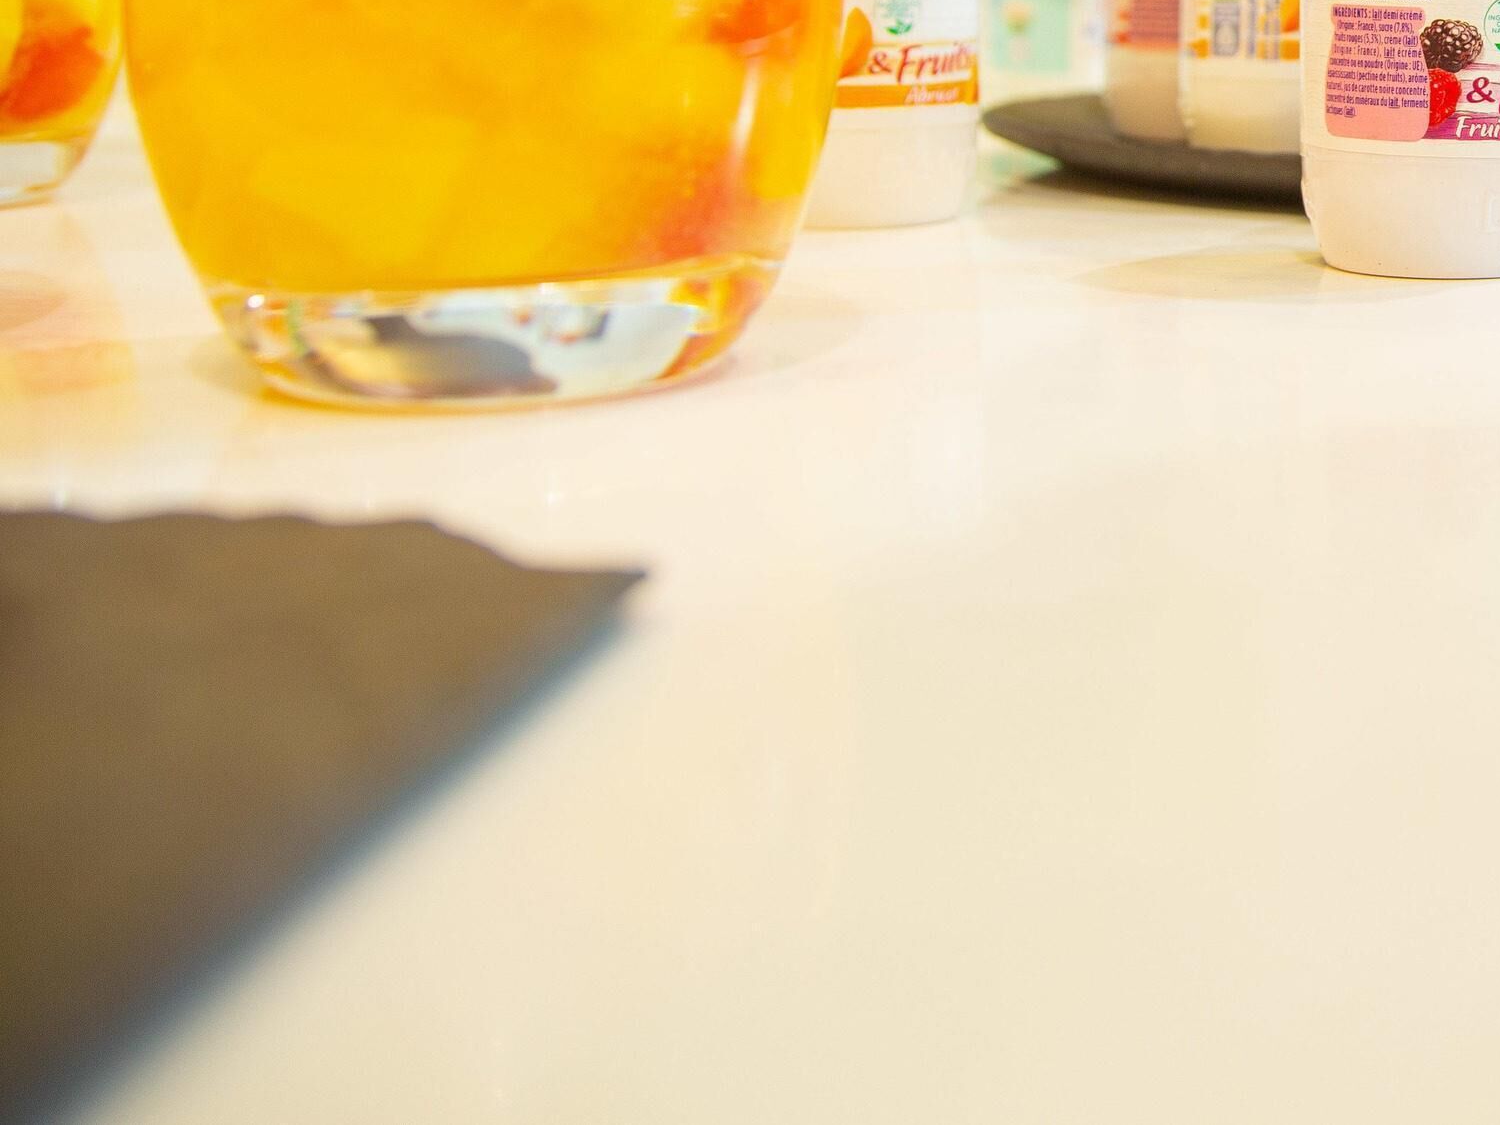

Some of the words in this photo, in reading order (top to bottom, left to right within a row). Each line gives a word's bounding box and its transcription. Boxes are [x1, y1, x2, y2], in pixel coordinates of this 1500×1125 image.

[1372, 11, 1382, 19] lait
[1379, 24, 1392, 32] sucre
[1403, 36, 1418, 46] (lait)
[1384, 47, 1395, 57] lait
[1398, 49, 1422, 58] écrémé
[1359, 84, 1378, 92] carotte
[1379, 85, 1394, 93] noire
[1396, 86, 1428, 96] concentré,
[1466, 76, 1496, 104] &
[1402, 99, 1428, 108] ferments
